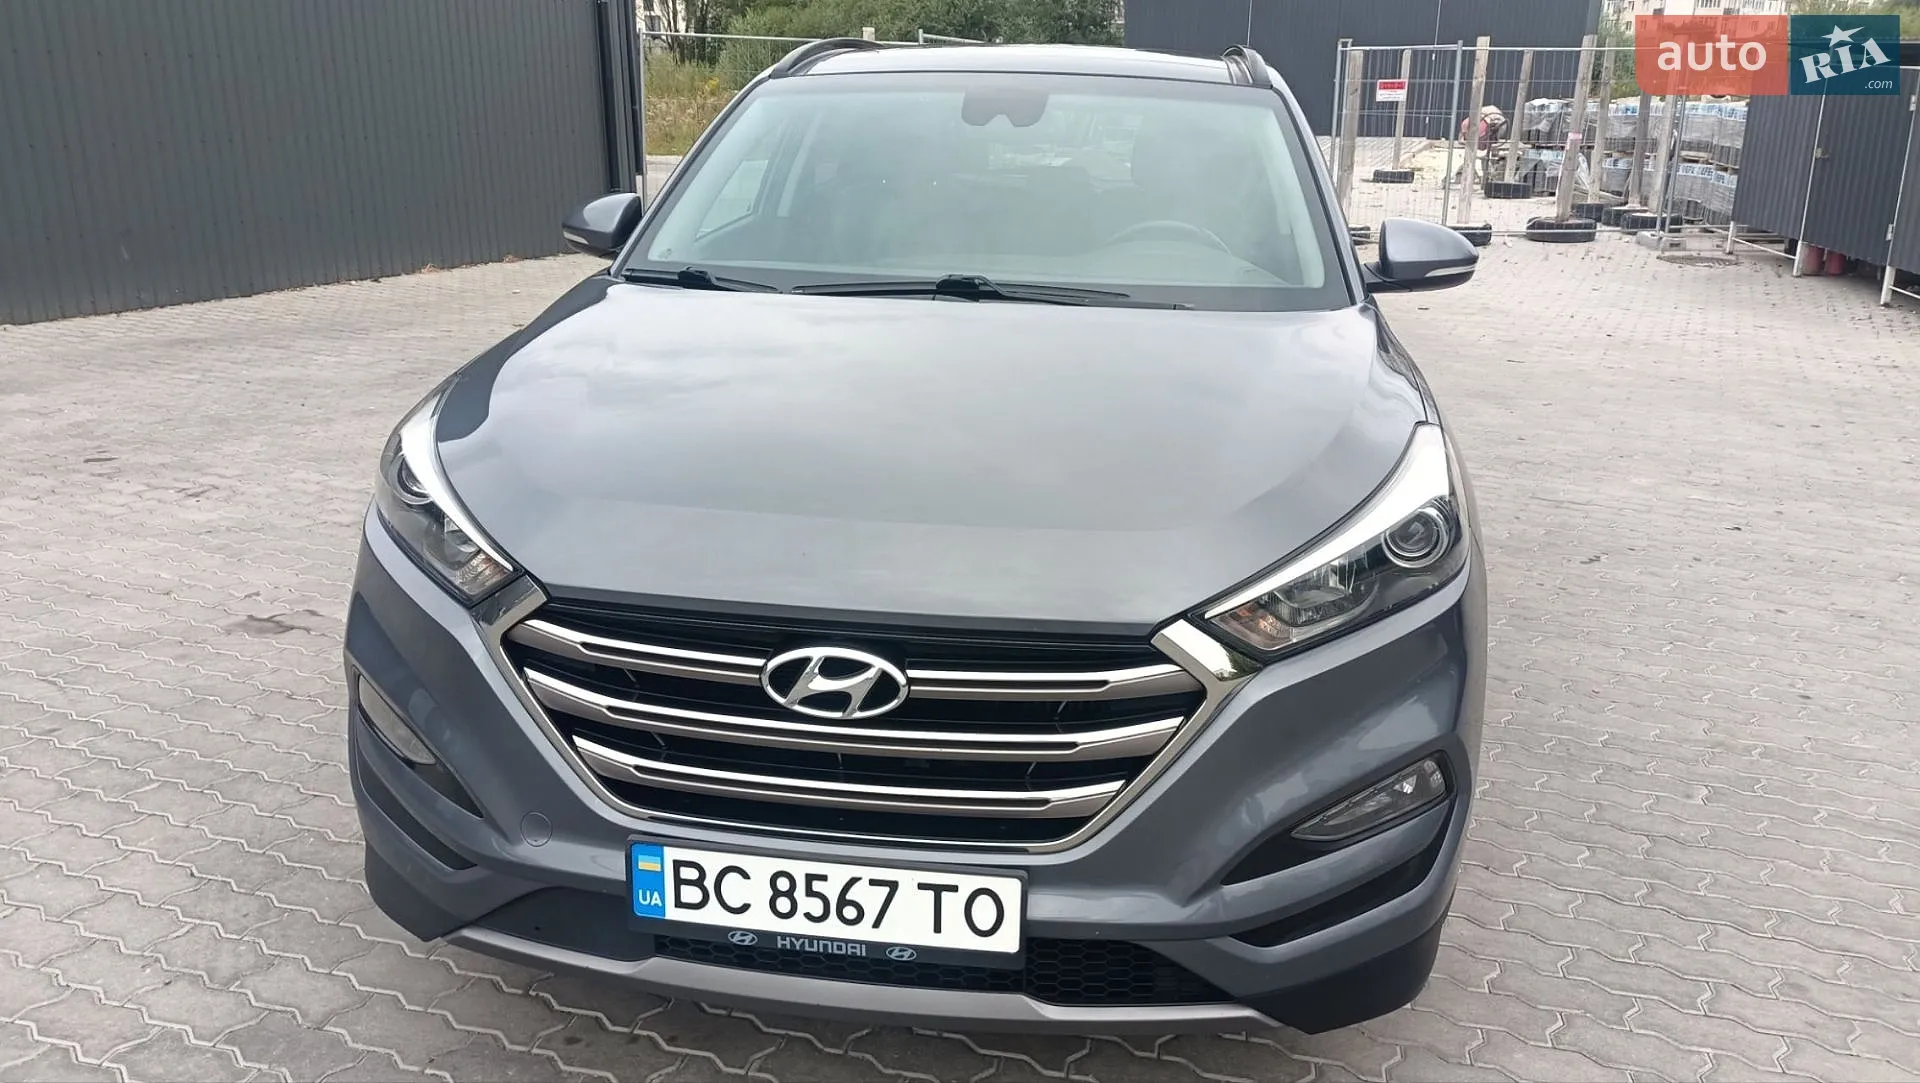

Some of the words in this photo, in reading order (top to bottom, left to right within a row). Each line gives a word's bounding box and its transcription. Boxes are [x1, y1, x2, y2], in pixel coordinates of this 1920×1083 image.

[638, 889, 662, 907] UA
[672, 859, 752, 915] BC
[769, 869, 898, 930] 8567
[917, 882, 1005, 938] TO
[776, 935, 867, 957] HYUNDAI
